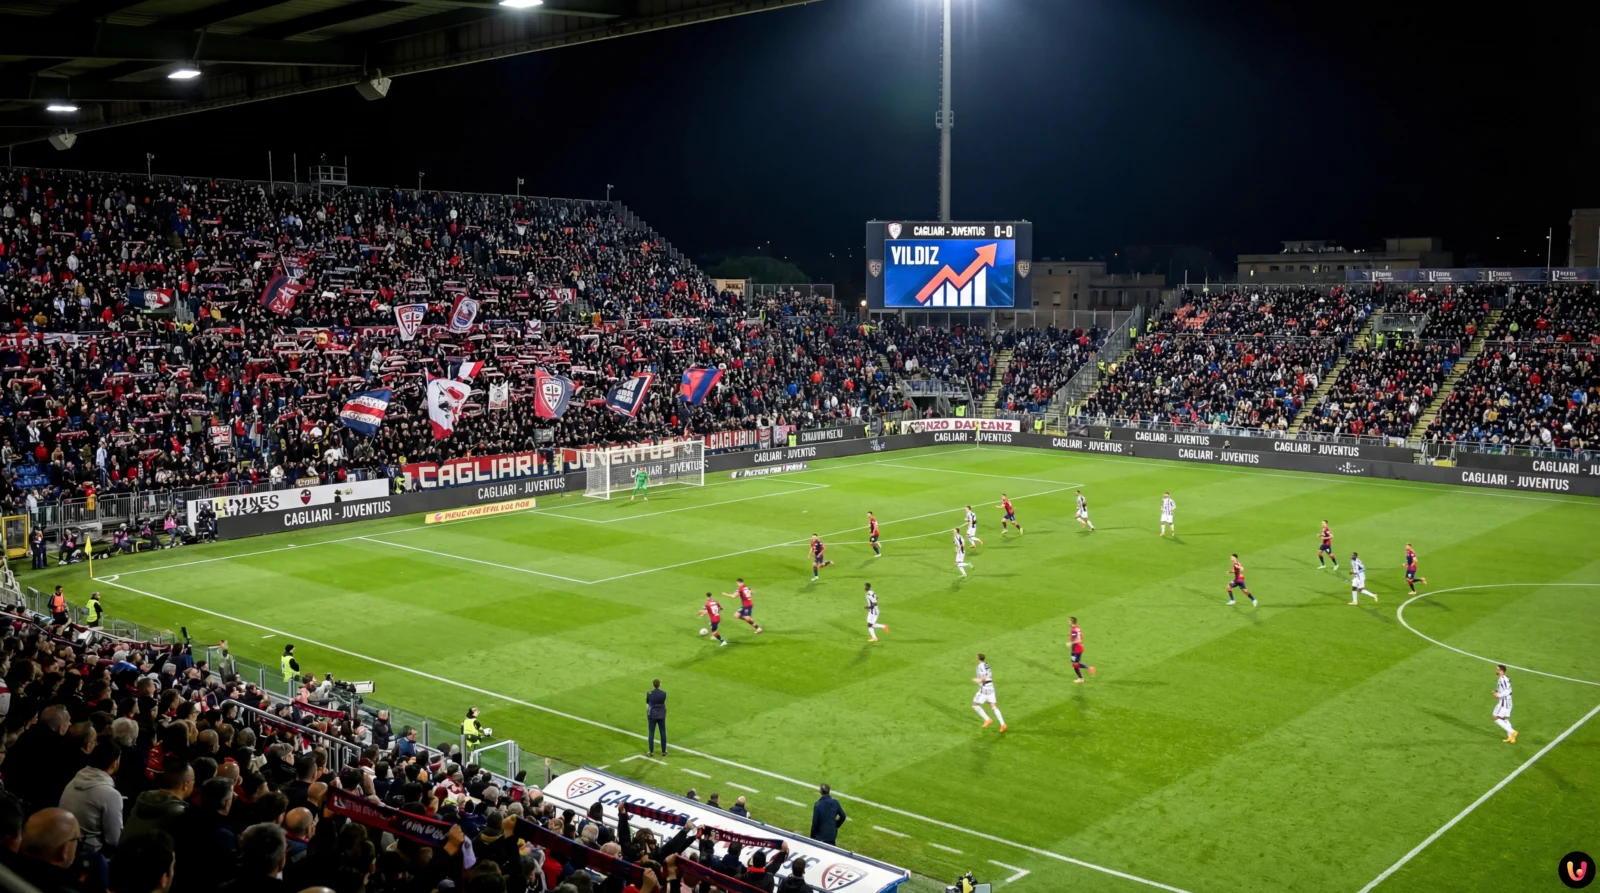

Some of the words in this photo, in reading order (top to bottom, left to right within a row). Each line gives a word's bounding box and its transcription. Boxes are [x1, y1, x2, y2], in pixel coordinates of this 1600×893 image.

[914, 226, 944, 235] CAGLIARI
[951, 227, 985, 236] JUVENTUS
[995, 226, 1012, 237] 0-0
[935, 433, 967, 441] CAGLIARI
[1136, 432, 1167, 442] CAGLIARI
[1174, 435, 1209, 445] JUVENTUS
[1053, 438, 1082, 448] CAGLIARI
[1088, 442, 1122, 452] JUVENTUS
[1275, 442, 1310, 452] CAGLIARI
[1318, 445, 1359, 456] JUVENTUS
[1179, 449, 1213, 459] CAGLIARI
[1220, 452, 1258, 463] JUVENTUS
[419, 453, 538, 488] CAGLIARI
[1533, 461, 1579, 473] CAGLIARI
[1462, 472, 1507, 485] CAGLIARI
[1517, 476, 1569, 490] JUVENTUS
[478, 484, 516, 499] CAGLIARI
[525, 478, 564, 493] JUVENTUS
[284, 508, 331, 526] CAGLIARI
[341, 501, 390, 518] JUVENTUS
